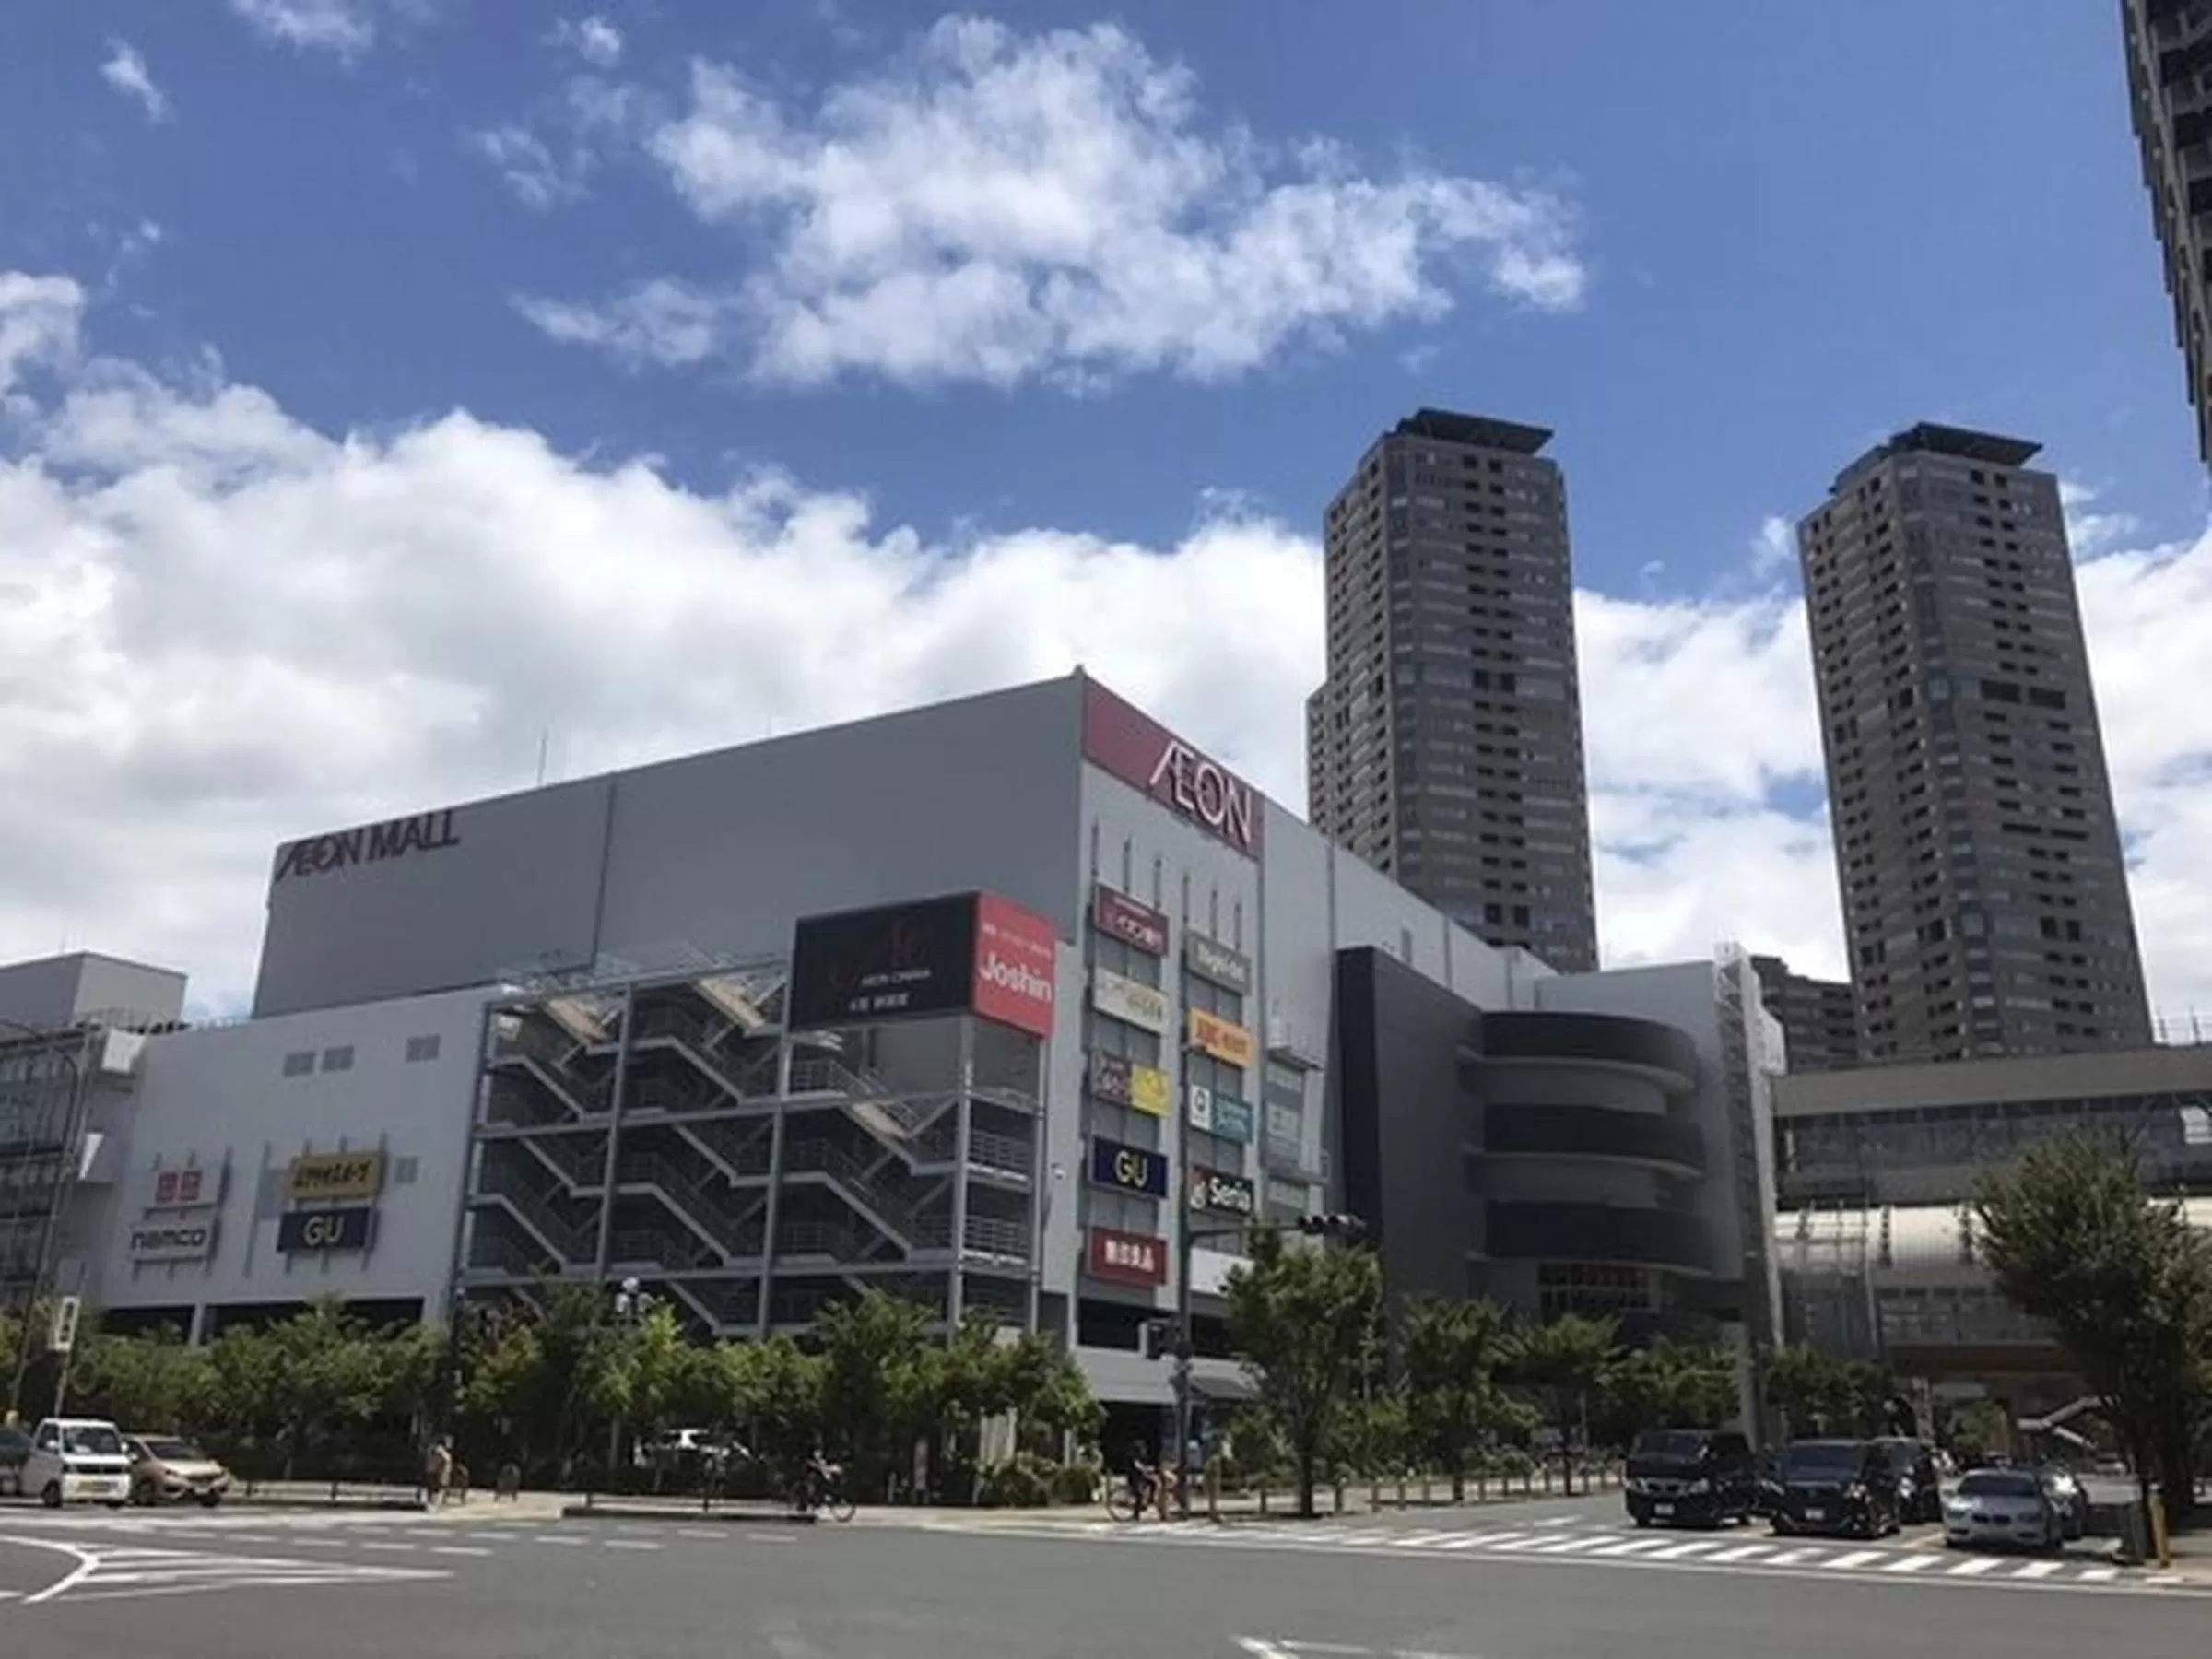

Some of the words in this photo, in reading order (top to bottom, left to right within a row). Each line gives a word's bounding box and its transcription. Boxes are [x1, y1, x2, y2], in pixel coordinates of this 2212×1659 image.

[366, 808, 462, 861] MALL
[978, 951, 1052, 1003] Joshin
[1114, 1150, 1148, 1188] GU
[303, 1215, 344, 1246] GU
